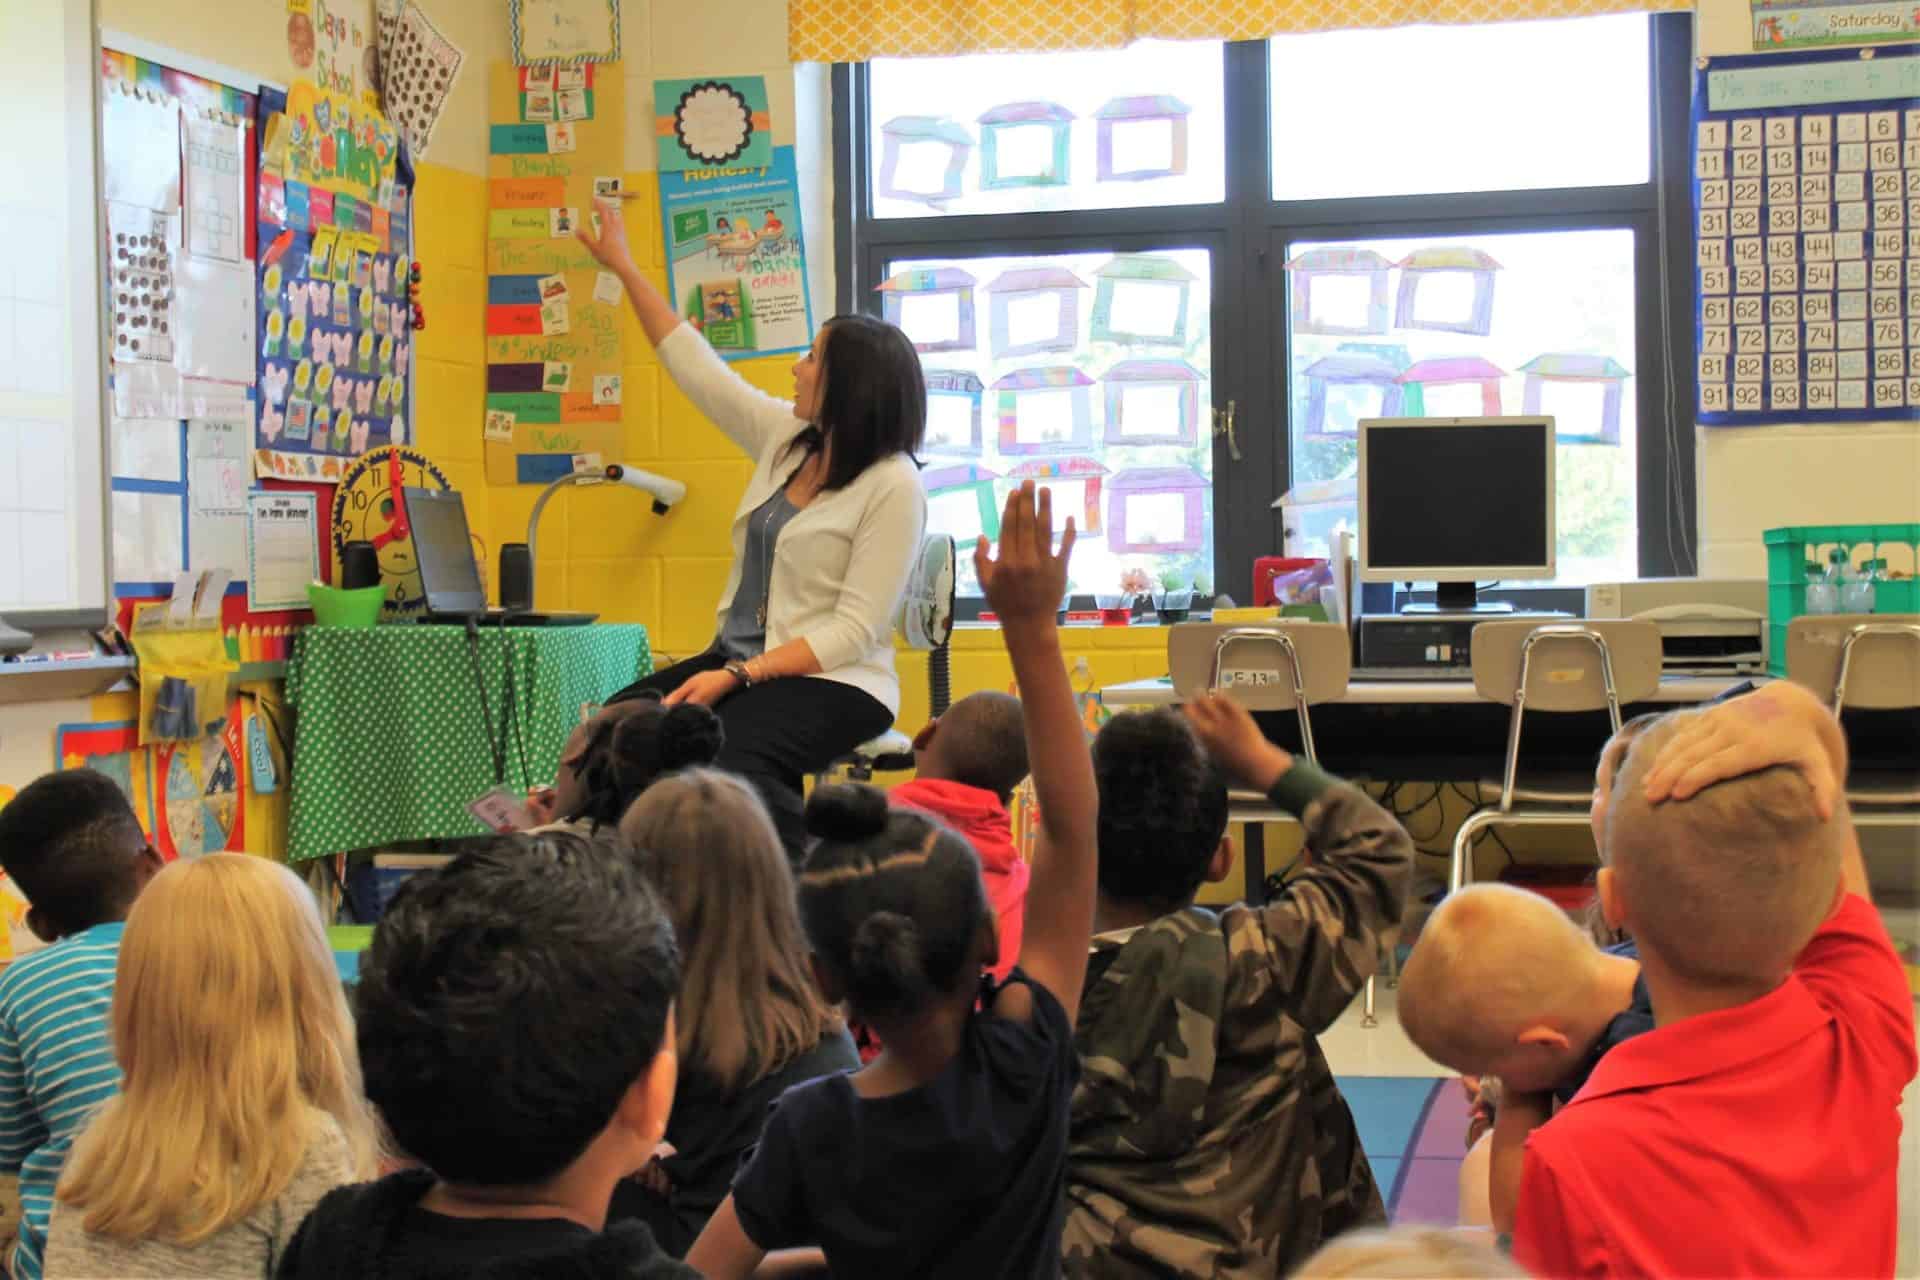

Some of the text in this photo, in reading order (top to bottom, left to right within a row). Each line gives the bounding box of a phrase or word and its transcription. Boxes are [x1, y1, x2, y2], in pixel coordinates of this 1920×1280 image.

[1830, 13, 1900, 29] Saturday
[1708, 128, 1714, 143] 1
[1741, 125, 1752, 141] 2
[1774, 123, 1786, 139] 3
[1810, 122, 1822, 138] 4
[1878, 119, 1890, 135] 6
[1701, 156, 1717, 172] 11
[1739, 154, 1758, 170] 12
[1772, 152, 1792, 168] 13
[1808, 152, 1826, 167] 14
[1876, 147, 1895, 163] 16
[1704, 185, 1723, 200] 21
[1735, 184, 1757, 200] 22
[1770, 182, 1794, 199] 23
[1804, 180, 1826, 197] 24
[1875, 176, 1898, 192] 26
[1703, 214, 1722, 231] 31
[1734, 212, 1755, 229] 32
[1772, 211, 1795, 228] 33
[1804, 208, 1826, 226] 34
[1877, 205, 1900, 222] 36
[1701, 245, 1720, 261] 41
[1736, 243, 1758, 259] 42
[1770, 241, 1793, 258] 43
[1807, 239, 1829, 254] 44
[1876, 235, 1900, 252] 46
[1704, 272, 1723, 288] 51
[1739, 270, 1761, 287] 52
[1772, 268, 1795, 286] 53
[1808, 268, 1830, 284] 54
[1874, 264, 1898, 282] 56
[1705, 302, 1725, 319] 61
[1736, 300, 1759, 318] 62
[1772, 300, 1795, 317] 63
[1805, 299, 1828, 315] 64
[1874, 296, 1896, 313] 66
[1706, 331, 1725, 347] 71
[1740, 330, 1762, 347] 72
[1773, 329, 1796, 345] 73
[1809, 328, 1831, 343] 74
[1877, 324, 1899, 341] 76
[1702, 358, 1721, 374] 81
[1737, 359, 1759, 376] 82
[1772, 358, 1796, 375] 83
[1810, 358, 1832, 374] 84
[1878, 354, 1901, 370] 86
[1704, 388, 1722, 404] 91
[1736, 387, 1758, 404] 92
[1774, 386, 1797, 403] 93
[1809, 386, 1832, 403] 94
[1877, 384, 1900, 401] 96
[372, 467, 381, 488] 11
[351, 490, 367, 511] 10
[342, 520, 353, 539] 9
[395, 583, 405, 602] 6
